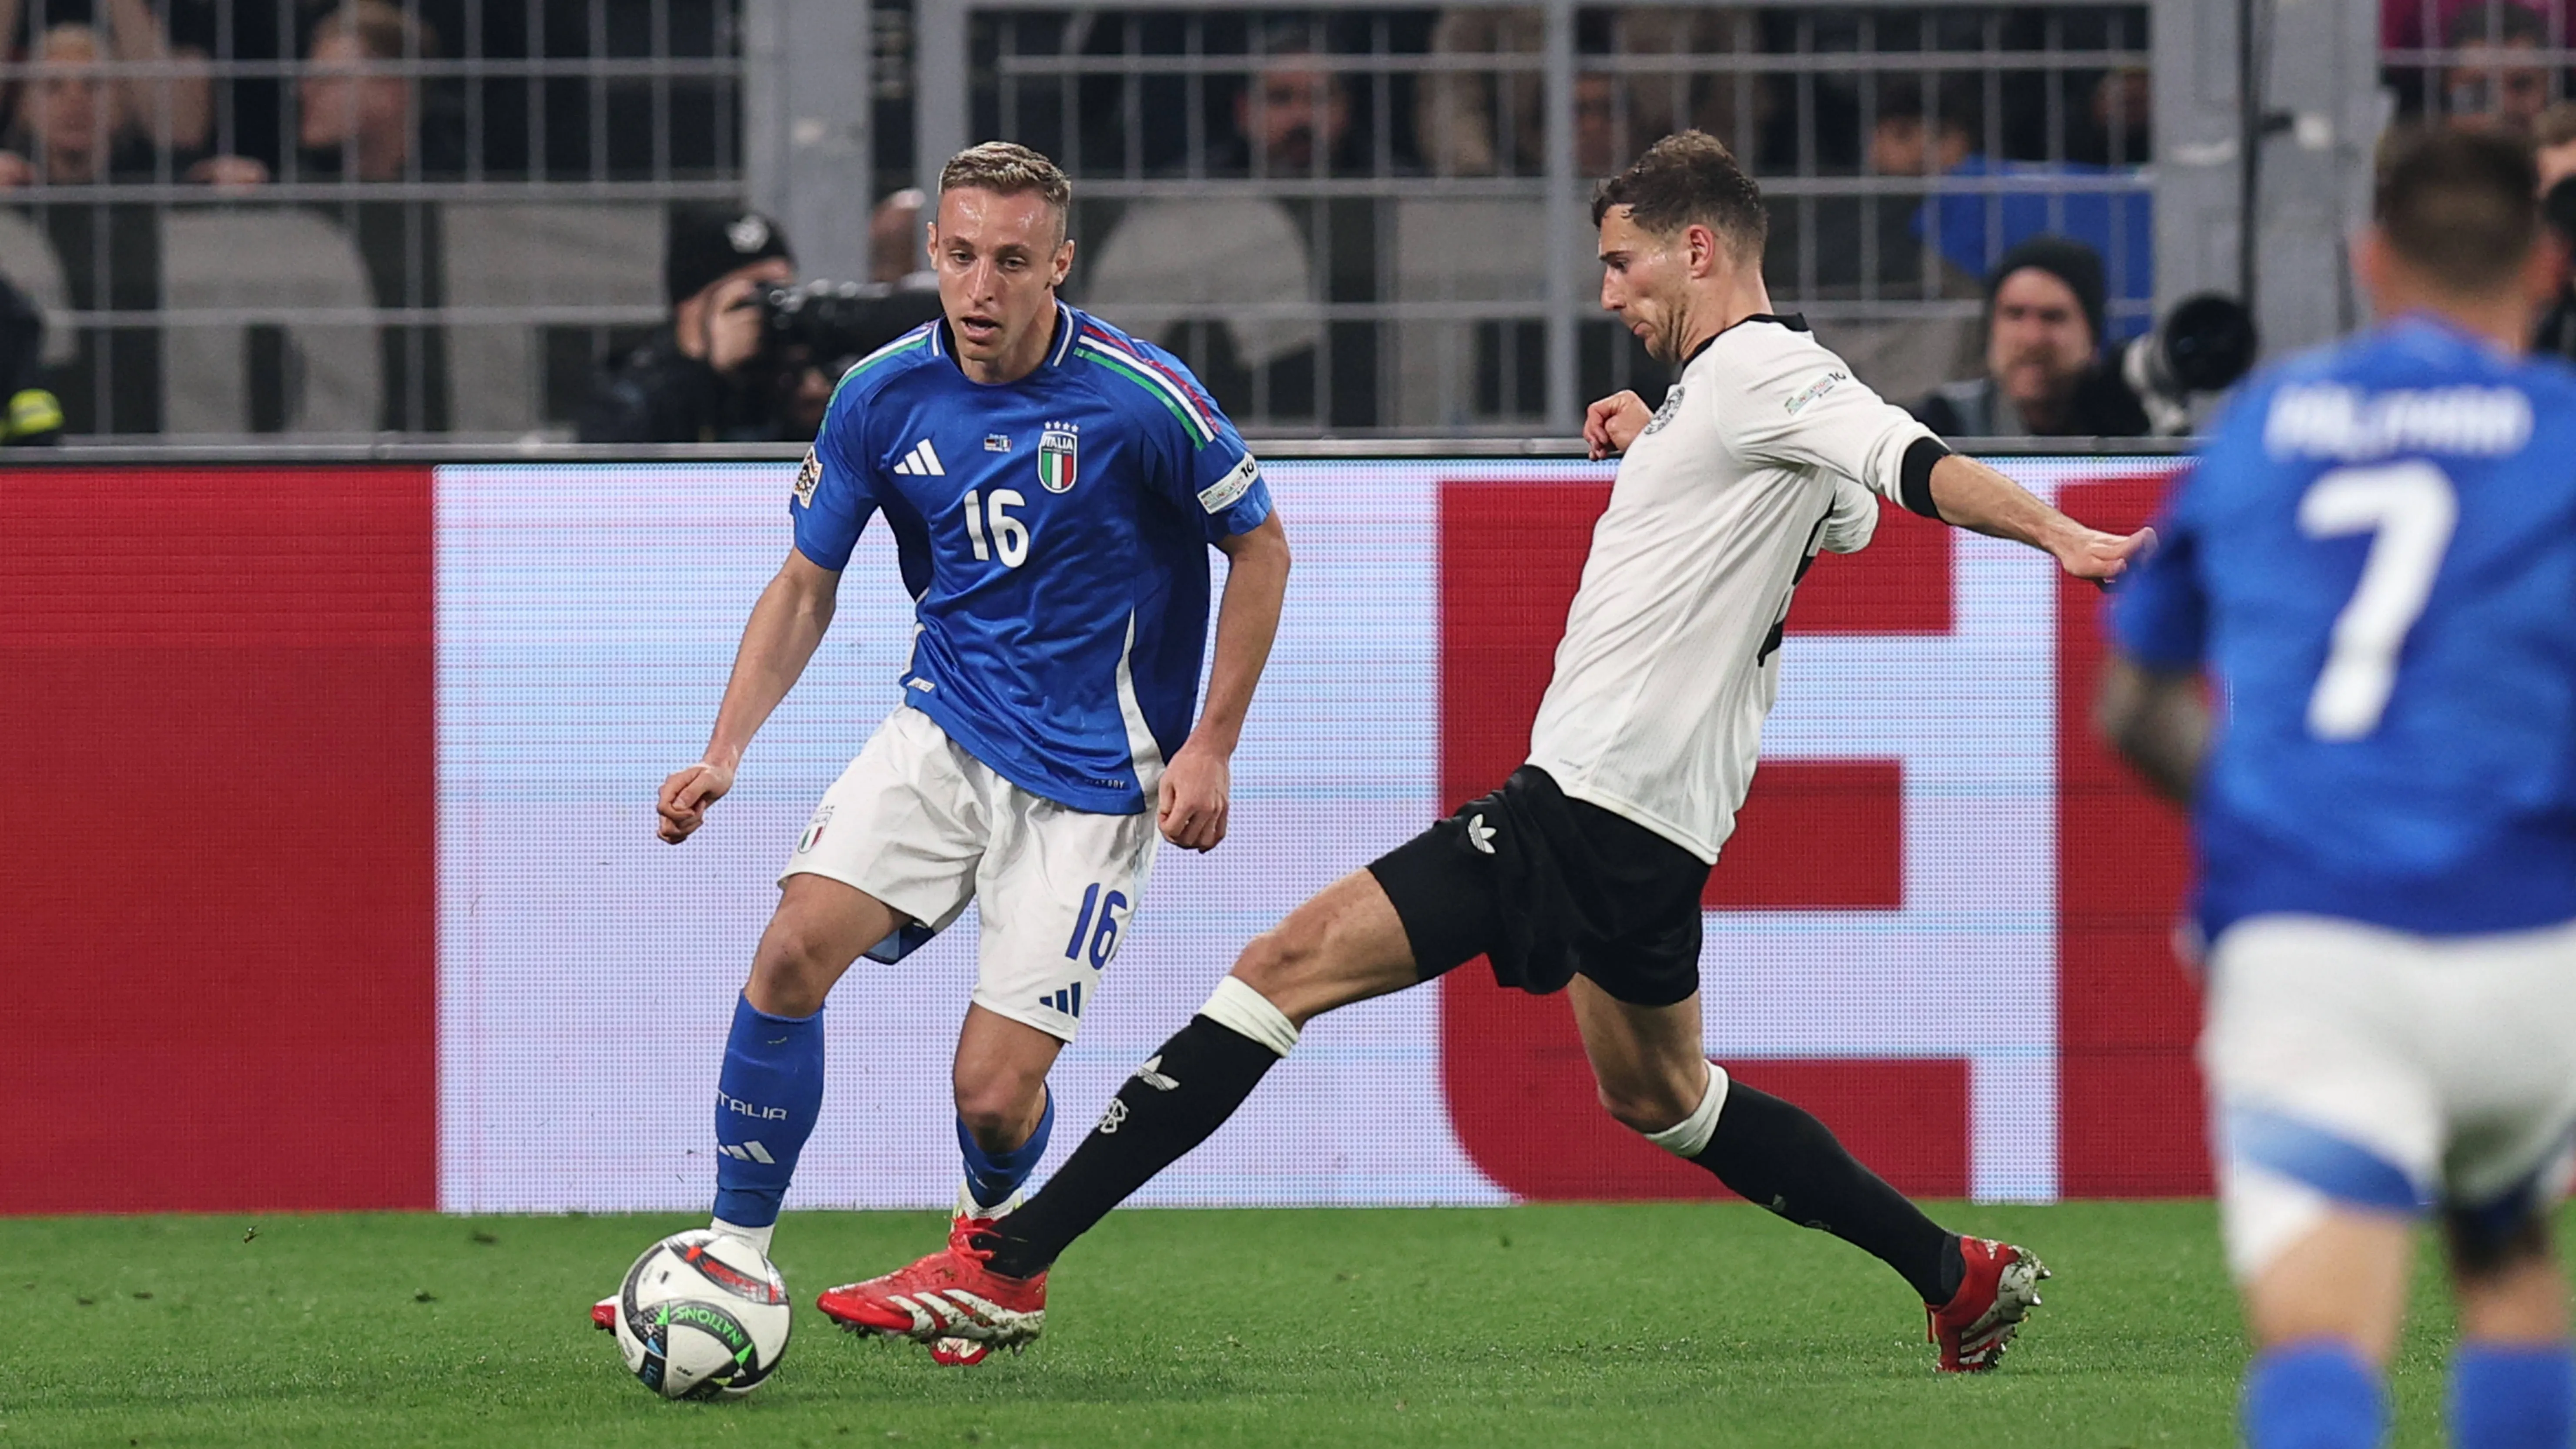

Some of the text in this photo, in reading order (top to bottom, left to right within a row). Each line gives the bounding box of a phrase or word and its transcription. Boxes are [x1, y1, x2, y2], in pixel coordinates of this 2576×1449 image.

[1041, 436, 1073, 450] ITALIA
[964, 489, 1029, 568] 16
[2298, 461, 2458, 740] 7
[1065, 882, 1127, 970] 16
[718, 1089, 788, 1120] TALIA
[676, 1306, 745, 1346] NATIONS
